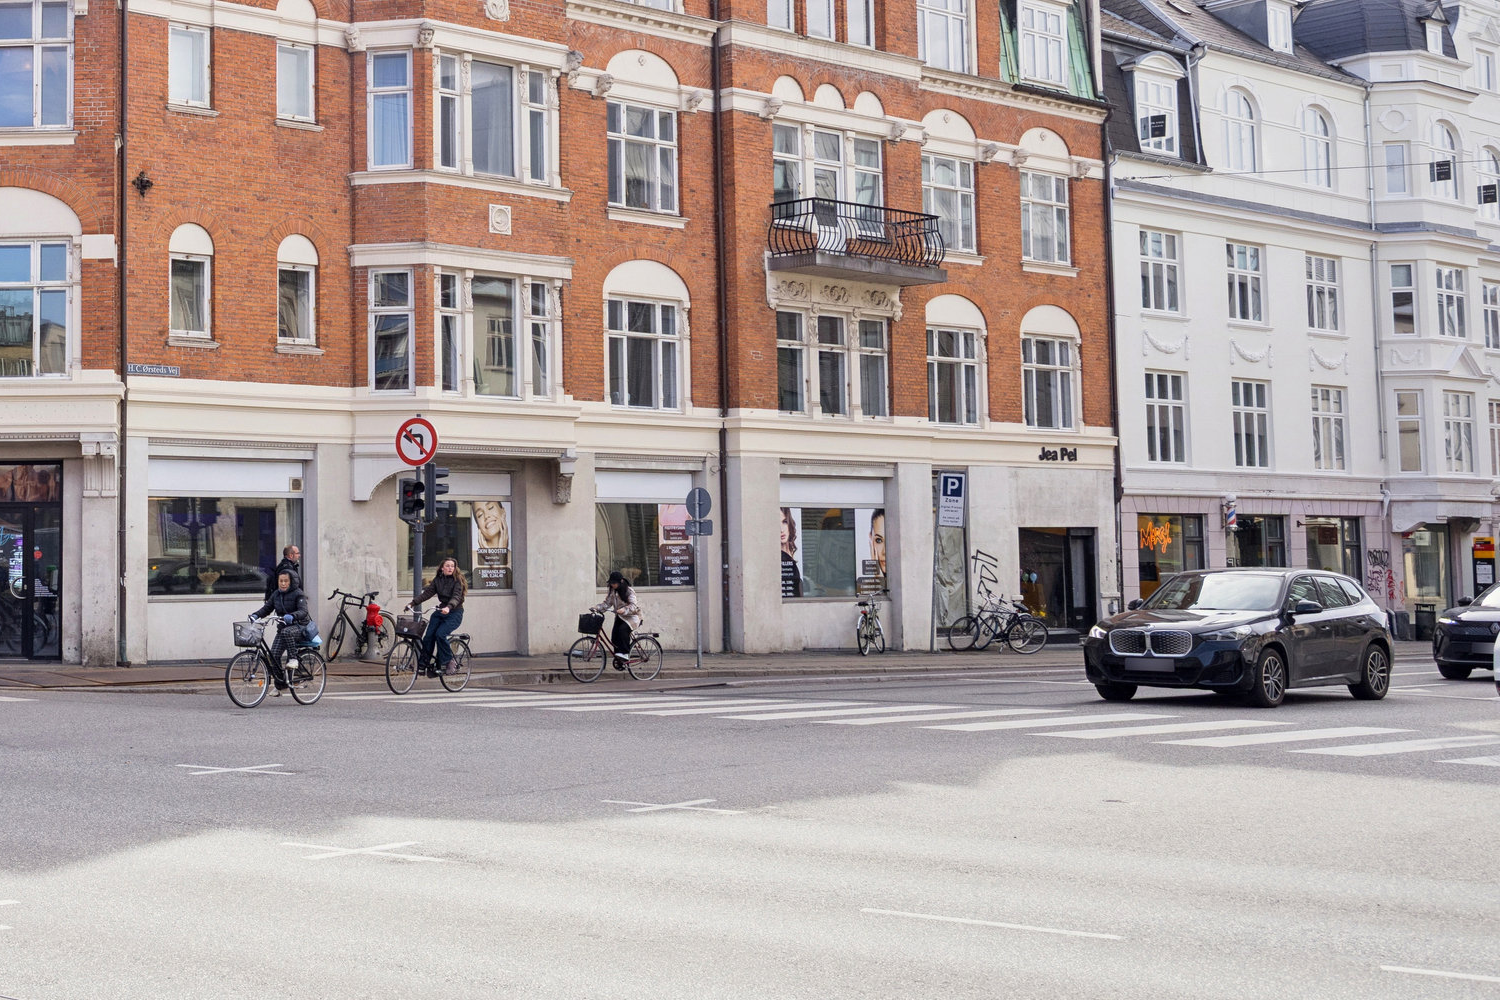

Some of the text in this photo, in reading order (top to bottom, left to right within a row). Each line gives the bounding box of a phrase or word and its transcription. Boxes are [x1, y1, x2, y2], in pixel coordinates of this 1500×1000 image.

[168, 366, 178, 375] Vej
[1039, 447, 1077, 461] Jea Pel
[947, 478, 959, 495] P
